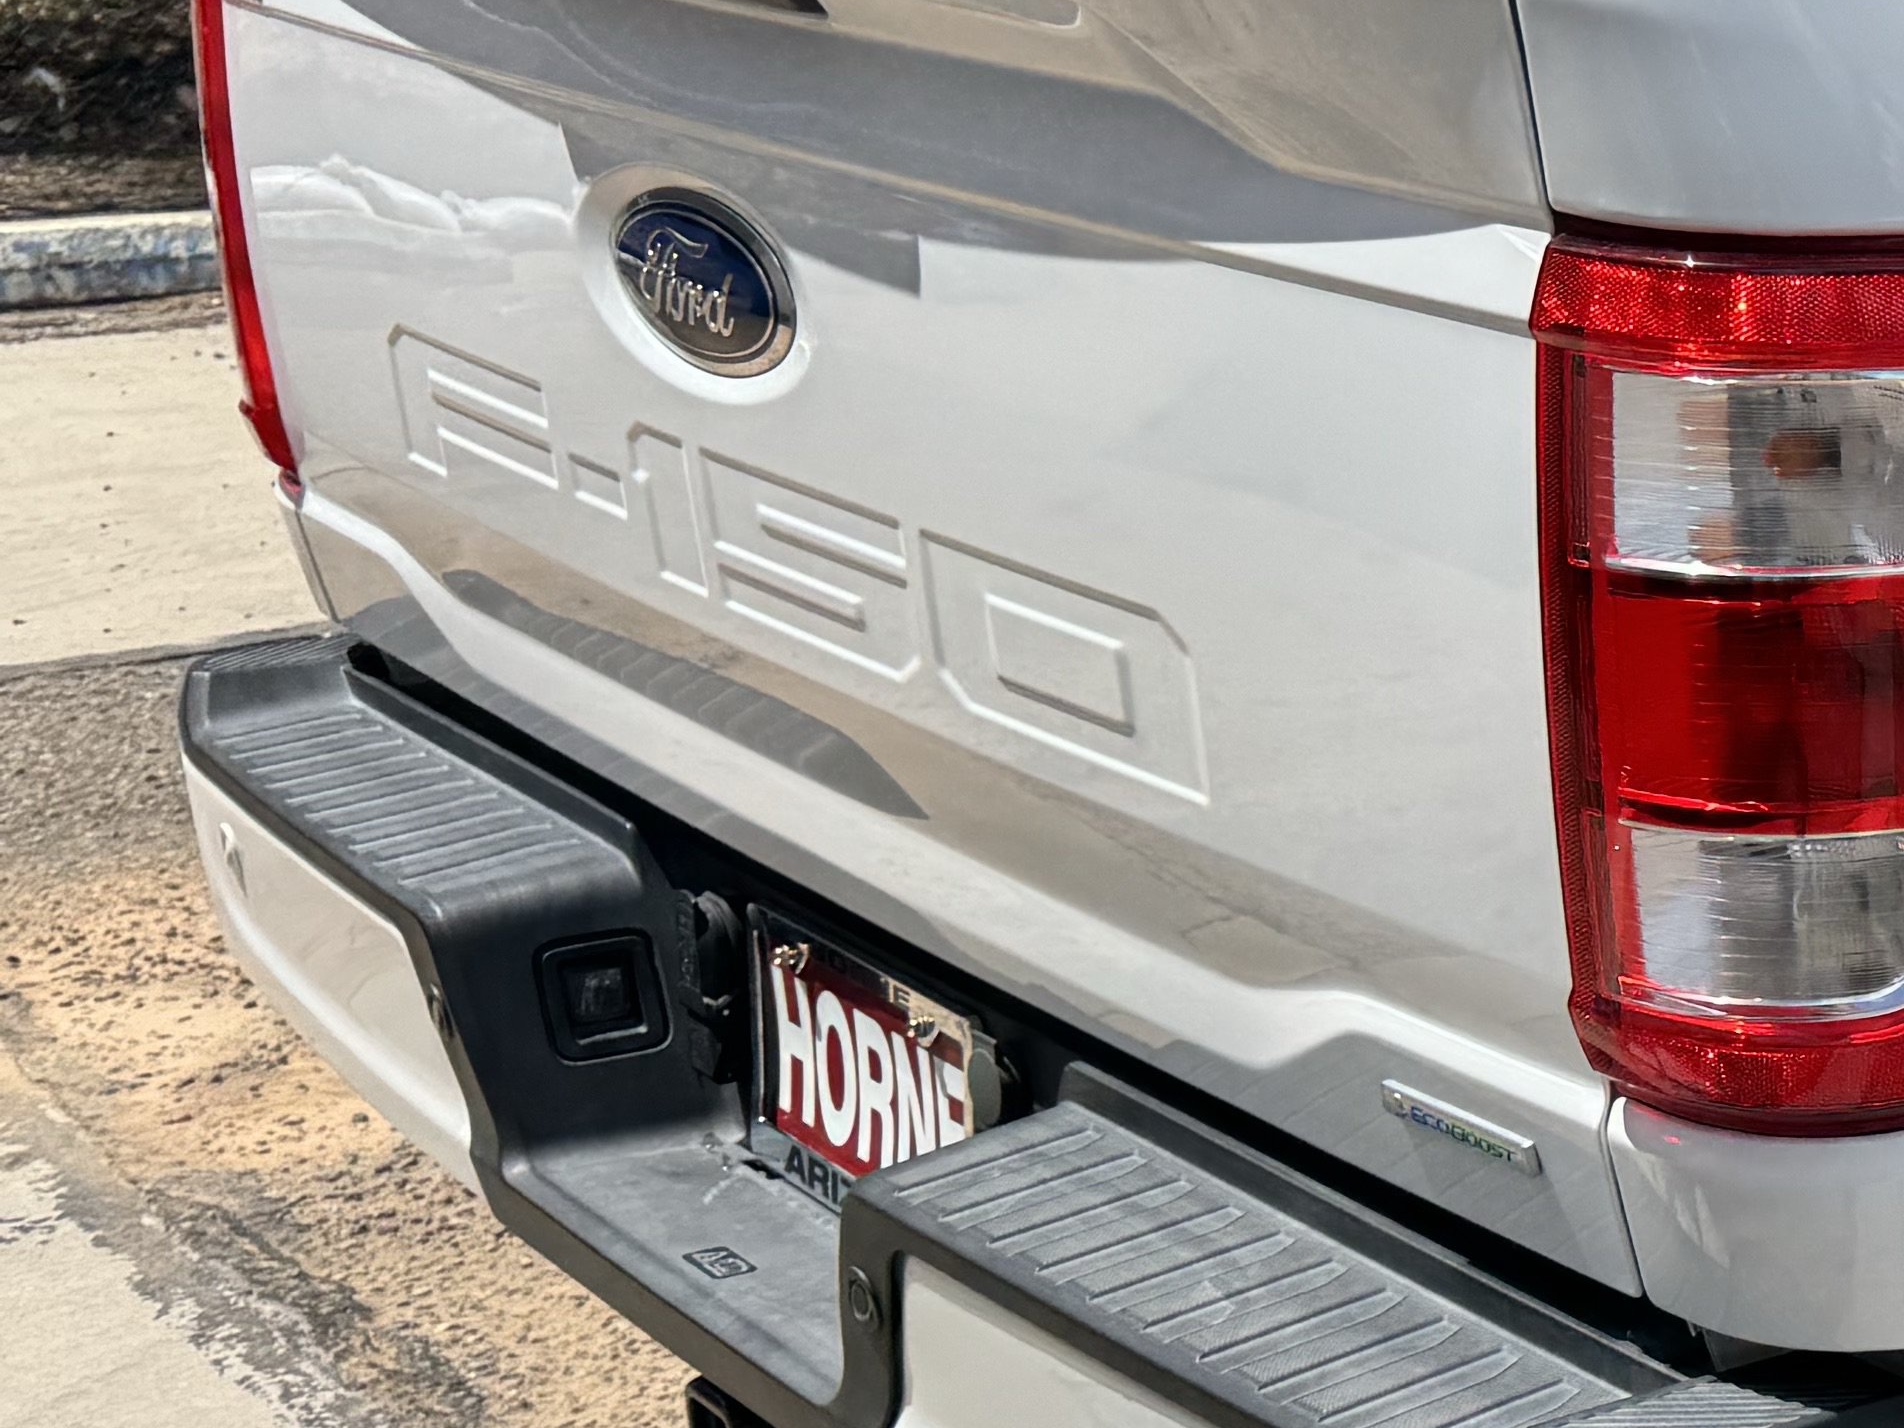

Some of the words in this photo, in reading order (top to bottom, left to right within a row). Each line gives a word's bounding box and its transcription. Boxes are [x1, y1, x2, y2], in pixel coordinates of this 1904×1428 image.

[640, 226, 735, 337] Ford
[387, 322, 1211, 806] F-150
[771, 963, 966, 1170] HORNE
[784, 1144, 852, 1205] ARI
